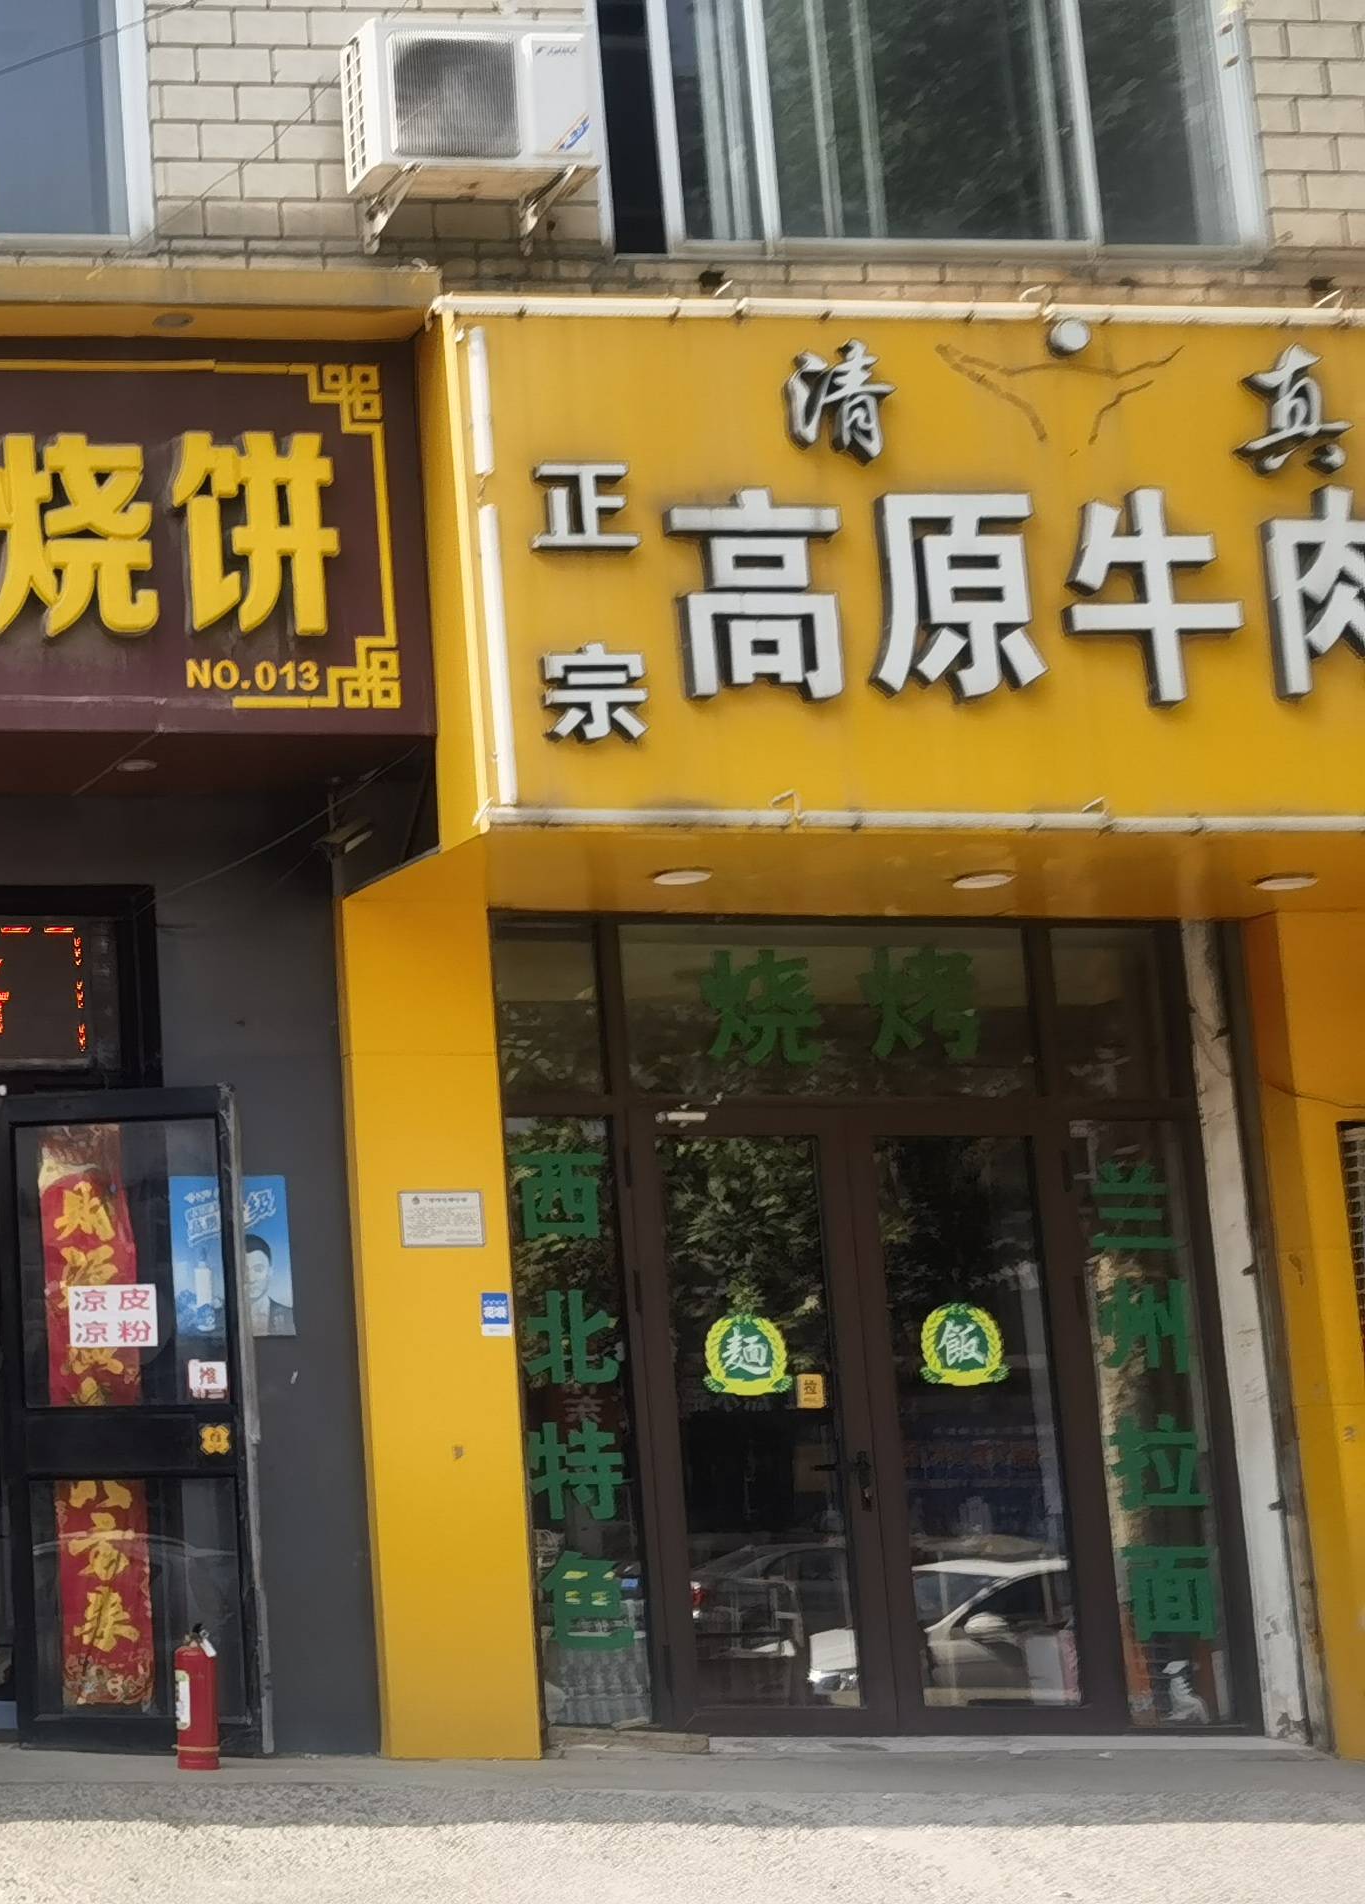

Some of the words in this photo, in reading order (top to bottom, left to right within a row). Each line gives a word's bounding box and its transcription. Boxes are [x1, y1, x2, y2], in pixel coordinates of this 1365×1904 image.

[785, 339, 896, 464] 清
[1233, 344, 1354, 475] 真
[530, 461, 650, 743] 正宗
[665, 485, 1365, 707] 高原牛肉
[186, 659, 319, 691] NO.013
[700, 945, 981, 1064] 烧烤
[73, 1289, 151, 1312] 凉皮
[74, 1321, 152, 1344] 凉粉
[510, 1153, 633, 1649] 西北特色
[1092, 1161, 1219, 1642] 兰州拉面
